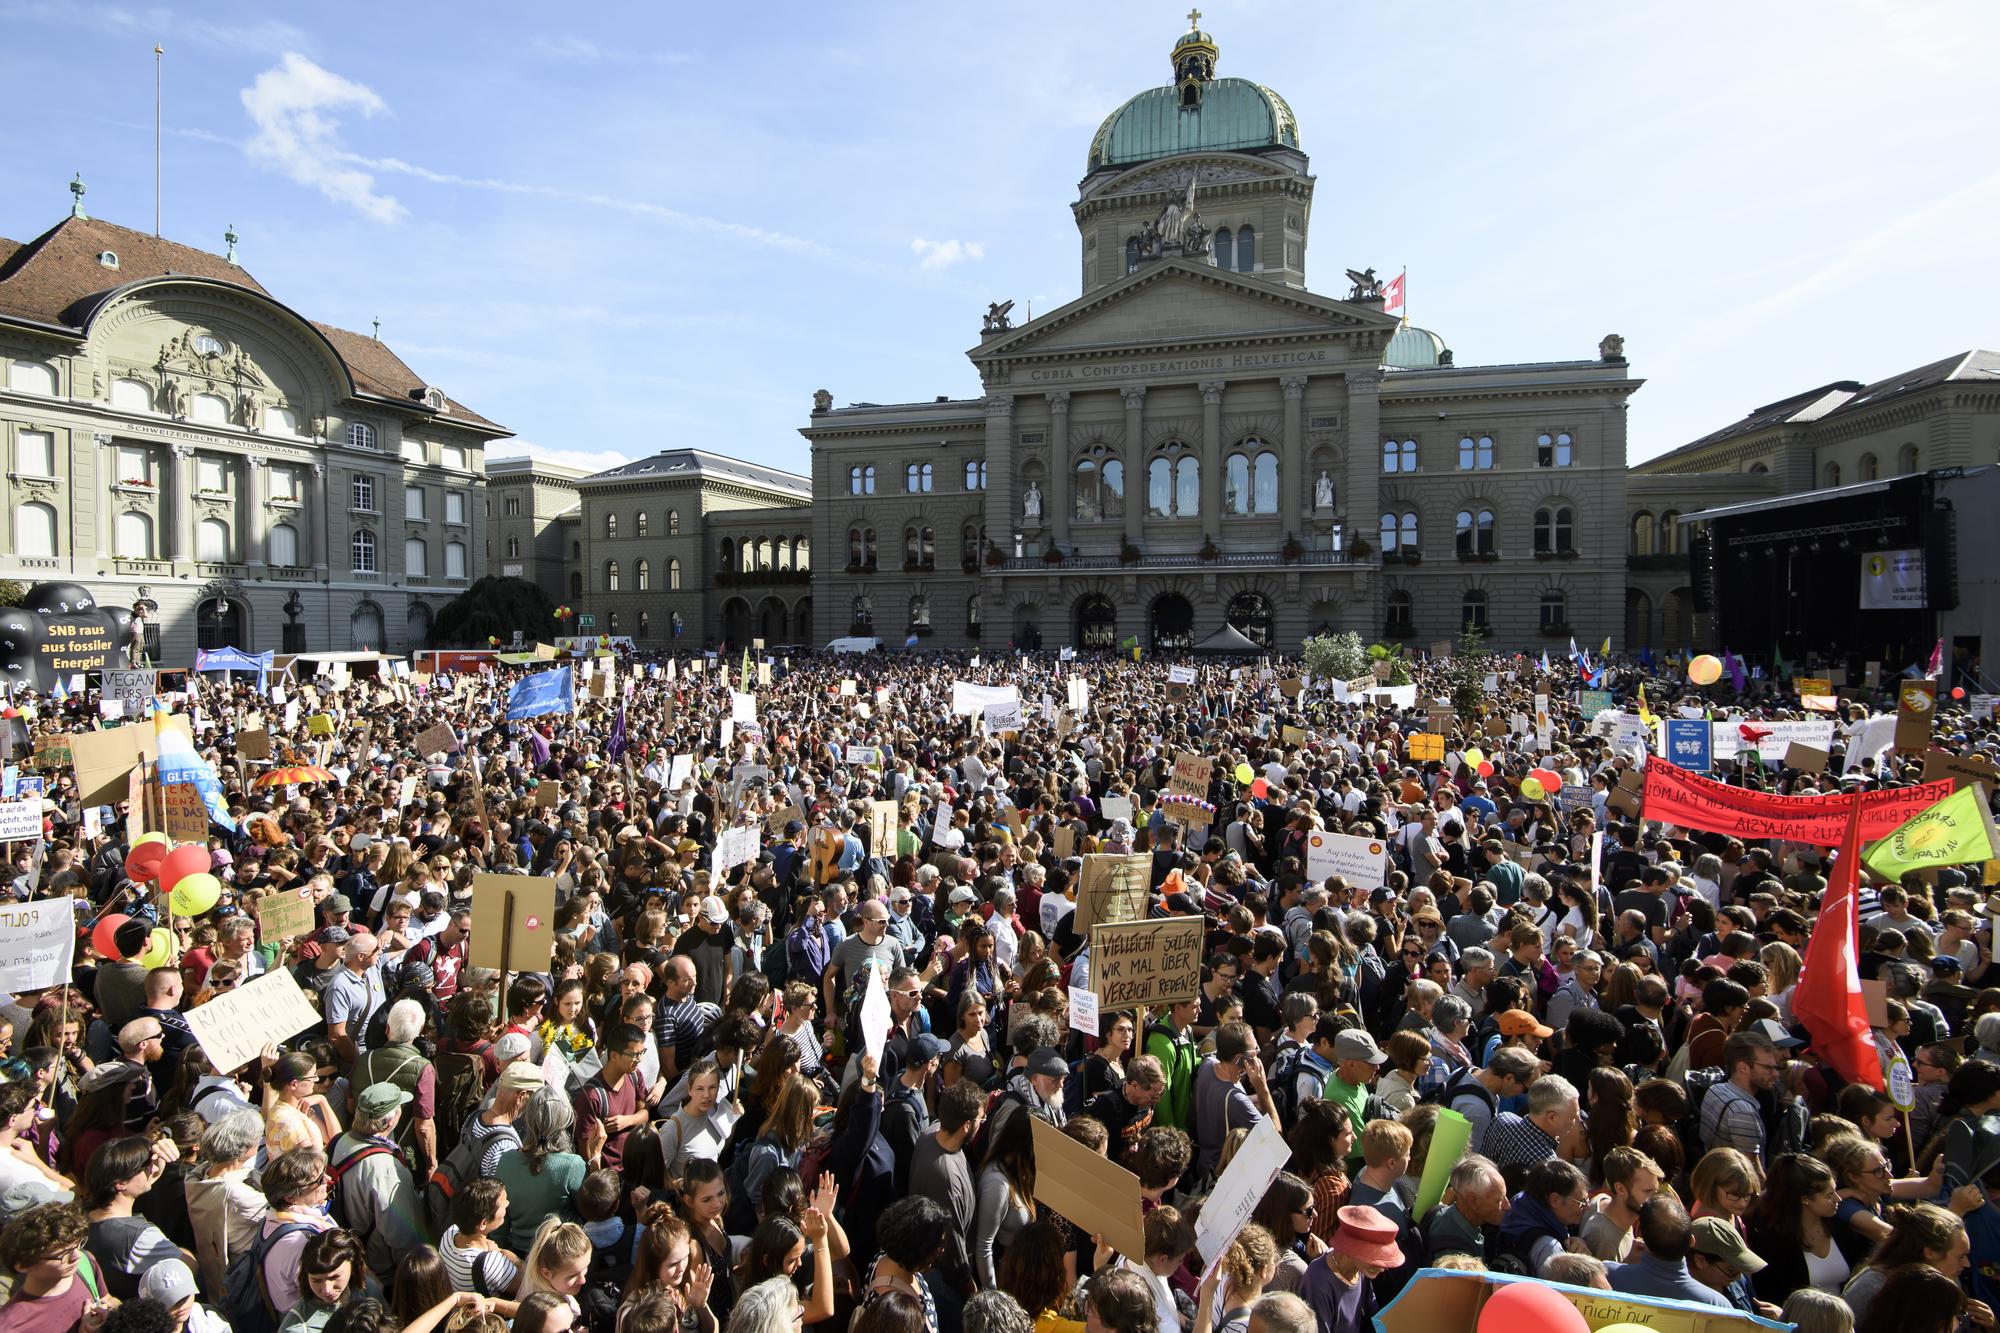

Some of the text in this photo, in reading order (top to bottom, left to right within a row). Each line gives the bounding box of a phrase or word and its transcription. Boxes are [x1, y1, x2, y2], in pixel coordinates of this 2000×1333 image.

[1031, 350, 1326, 380] CURIA CONFOEDERATIONIS HELVETICAE
[127, 423, 301, 456] SCHWEIZERISCHE NATIONALBANK
[48, 626, 105, 636] SNB raus
[42, 642, 66, 653] aus
[68, 640, 112, 653] fossiler
[53, 656, 104, 670] Energie!
[104, 672, 154, 686] VEGAN
[114, 686, 142, 698] FÜRS
[1176, 760, 1209, 780] WAKE UP
[1174, 775, 1206, 798] HUMANS
[23, 814, 40, 822] nicht
[184, 807, 204, 818] DAS
[158, 820, 205, 835] SHULE!
[1101, 926, 1199, 958] VIELLEICHT SOLLTEN
[1101, 952, 1191, 980] WIR MAL ÜBER
[1103, 970, 1198, 1006] VERZICHT REDEN?
[196, 974, 286, 1030] RAISE YOUR
[1074, 992, 1093, 1002] VALUES
[1072, 999, 1094, 1012] CHANGE,
[208, 992, 300, 1048] VOICE NOT THE
[1073, 1012, 1094, 1024] CLIMATE
[1074, 1018, 1094, 1030] CHANGE
[226, 1039, 256, 1062] SEA
[1583, 1305, 1654, 1324] nicht nur
